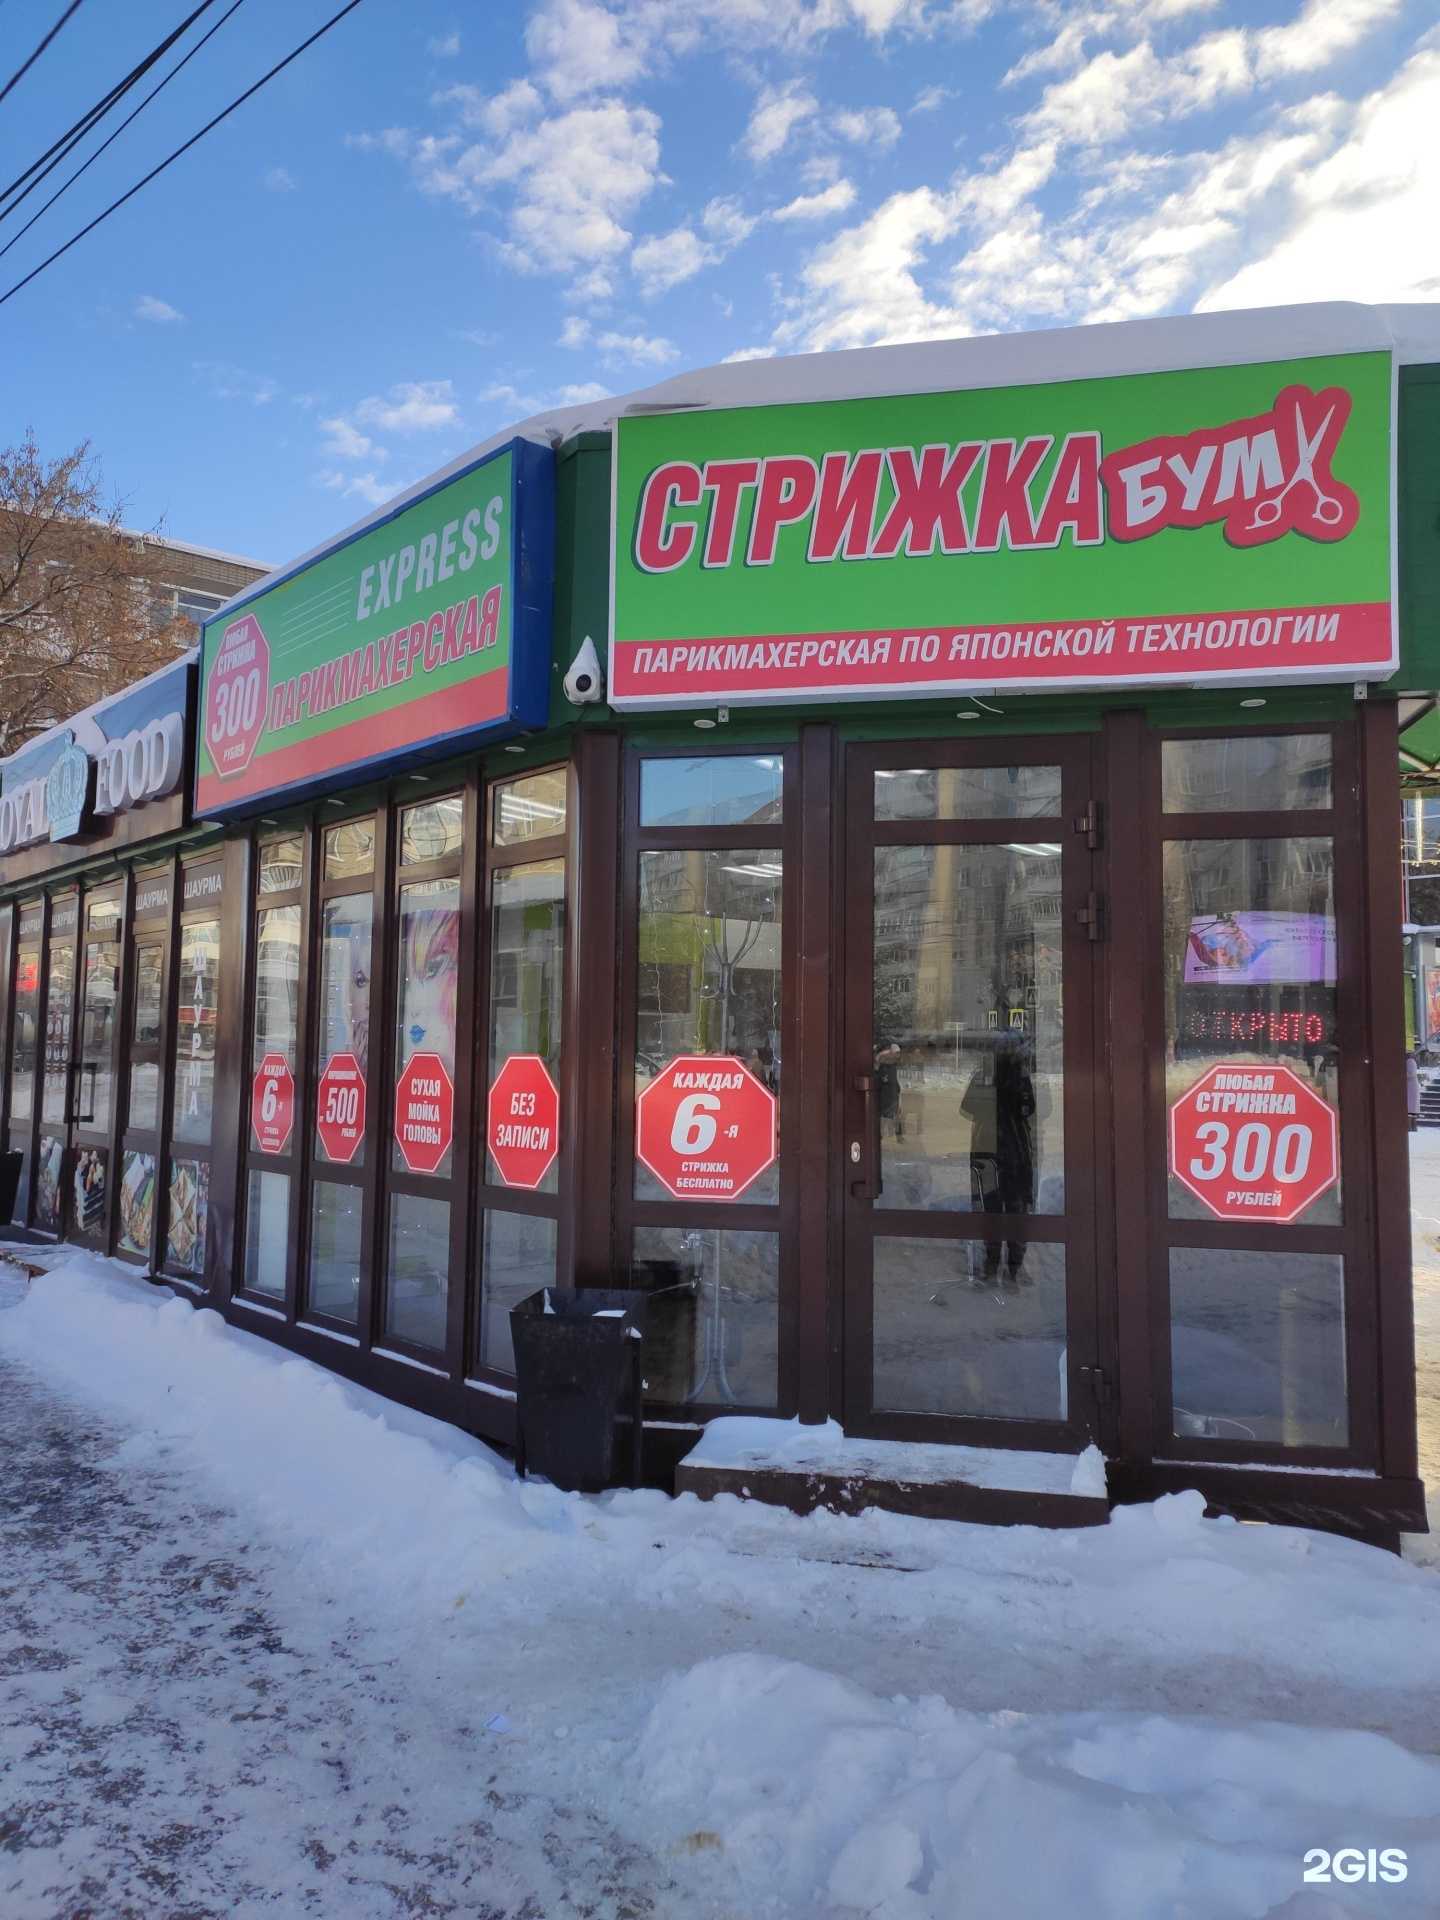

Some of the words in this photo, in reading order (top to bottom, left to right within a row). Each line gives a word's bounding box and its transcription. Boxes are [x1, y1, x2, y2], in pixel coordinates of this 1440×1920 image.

[632, 430, 1104, 573] СТРИЖКА
[1118, 429, 1285, 527] БУМ
[356, 496, 503, 621] EXPRESS
[632, 637, 891, 673] ПАРИКМАХЕРСКАЯ
[899, 634, 941, 662] ПО
[948, 620, 1114, 661] ЯПОНСКОЙ
[1126, 613, 1340, 653] ТЕХНОЛОГИИ
[217, 639, 256, 677] СТРИЖКА
[268, 584, 502, 733] ПАРИКМАХЕРСКАЯ
[211, 667, 260, 744] 300
[93, 711, 184, 816] FOOD
[184, 873, 222, 898] ШАУРМА
[135, 890, 169, 911] ШАУРМА
[1190, 1008, 1323, 1042] ОТКРЫТО
[411, 1078, 441, 1097] СУХАЯ
[673, 1072, 744, 1091] КАЖДАЯ
[1214, 1073, 1275, 1091] ЛЮБАЯ
[326, 1087, 359, 1125] 500
[408, 1101, 440, 1122] МОЙКА
[510, 1093, 535, 1116] БЕЗ
[1196, 1091, 1296, 1115] СТРИЖКА
[403, 1124, 441, 1145] ГОЛОВЫ
[496, 1124, 549, 1150] ЗАПИСИ
[1190, 1121, 1312, 1184] 300
[682, 1161, 729, 1173] СТРИЖКА
[676, 1177, 734, 1190] БЕСПЛАТНО
[1226, 1190, 1282, 1207] РУБЛЕЙ
